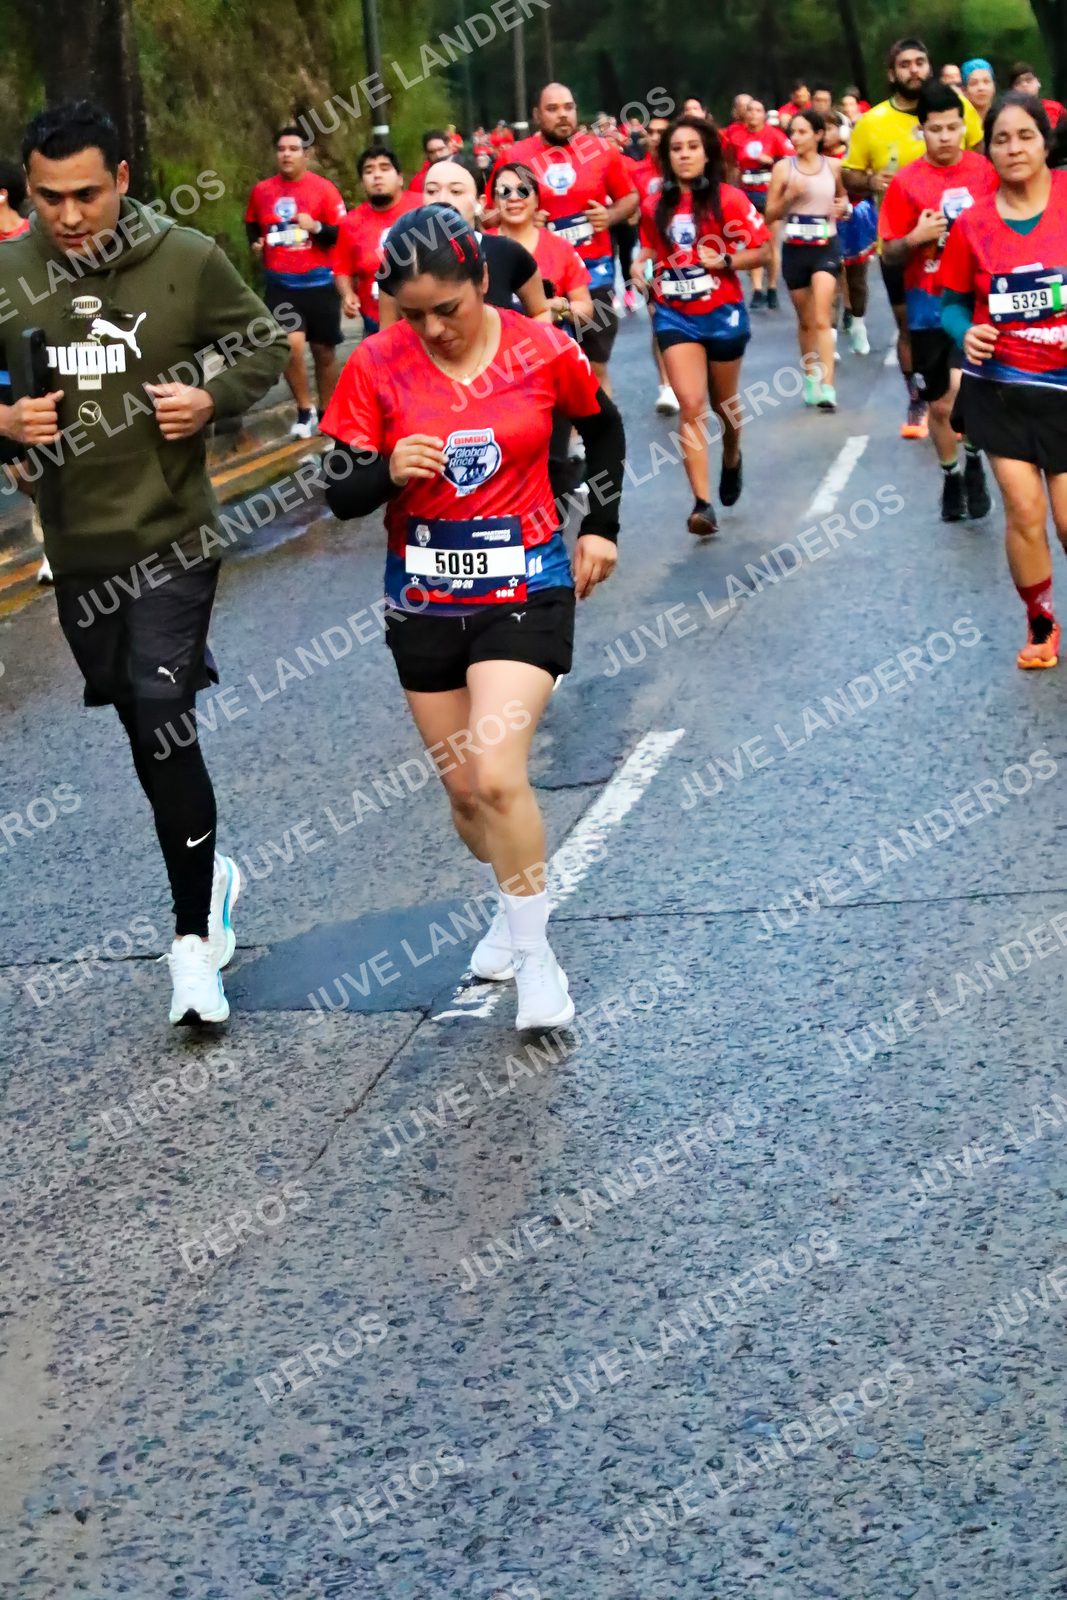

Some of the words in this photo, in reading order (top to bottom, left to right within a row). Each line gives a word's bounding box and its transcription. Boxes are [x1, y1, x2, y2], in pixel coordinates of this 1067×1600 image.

[73, 301, 99, 310] PUMA
[1012, 291, 1049, 310] 5329
[454, 436, 488, 445] BIMBO
[455, 446, 488, 459] Global
[449, 457, 475, 468] Race
[435, 551, 489, 575] 5093
[495, 588, 516, 598] 10K
